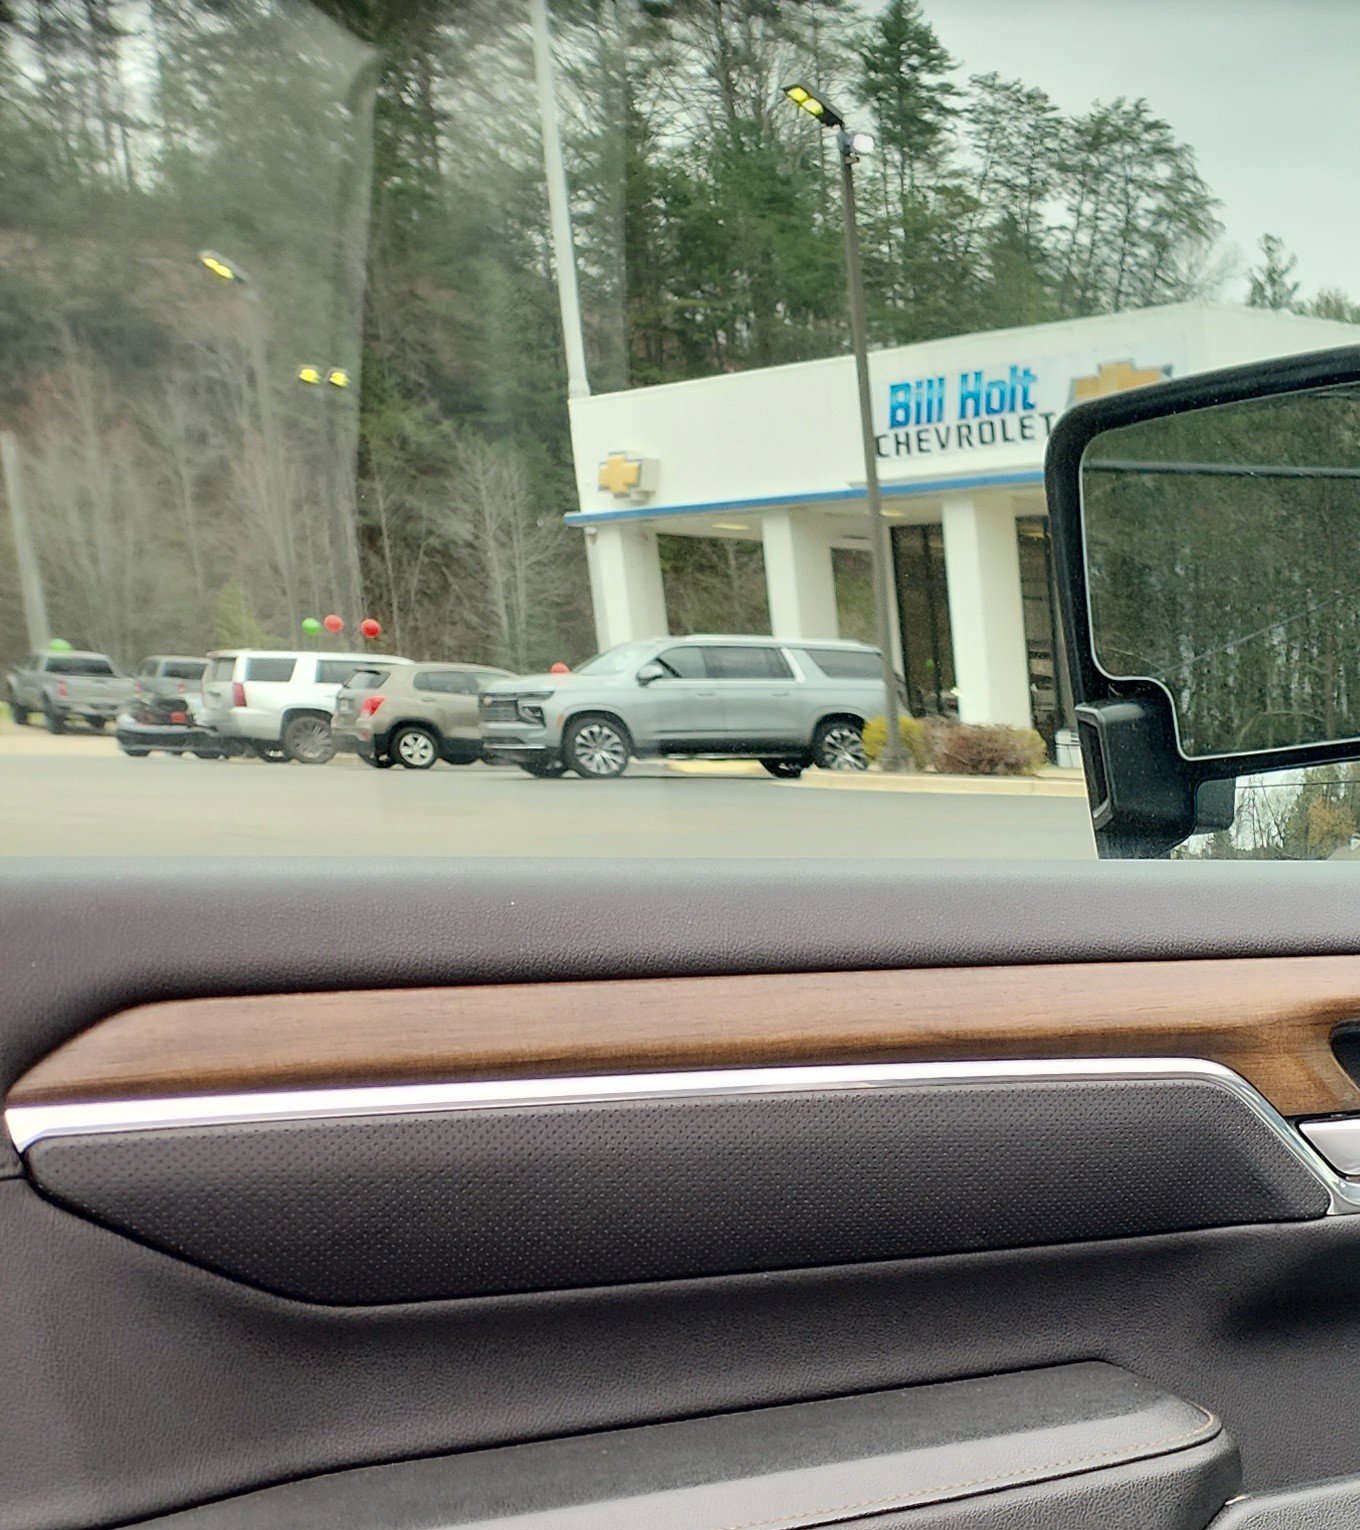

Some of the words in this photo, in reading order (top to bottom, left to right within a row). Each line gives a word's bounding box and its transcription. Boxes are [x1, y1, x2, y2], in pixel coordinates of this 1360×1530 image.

[889, 377, 945, 430] Bill
[959, 364, 1037, 420] Holt
[875, 412, 1056, 458] CHEVROLET
